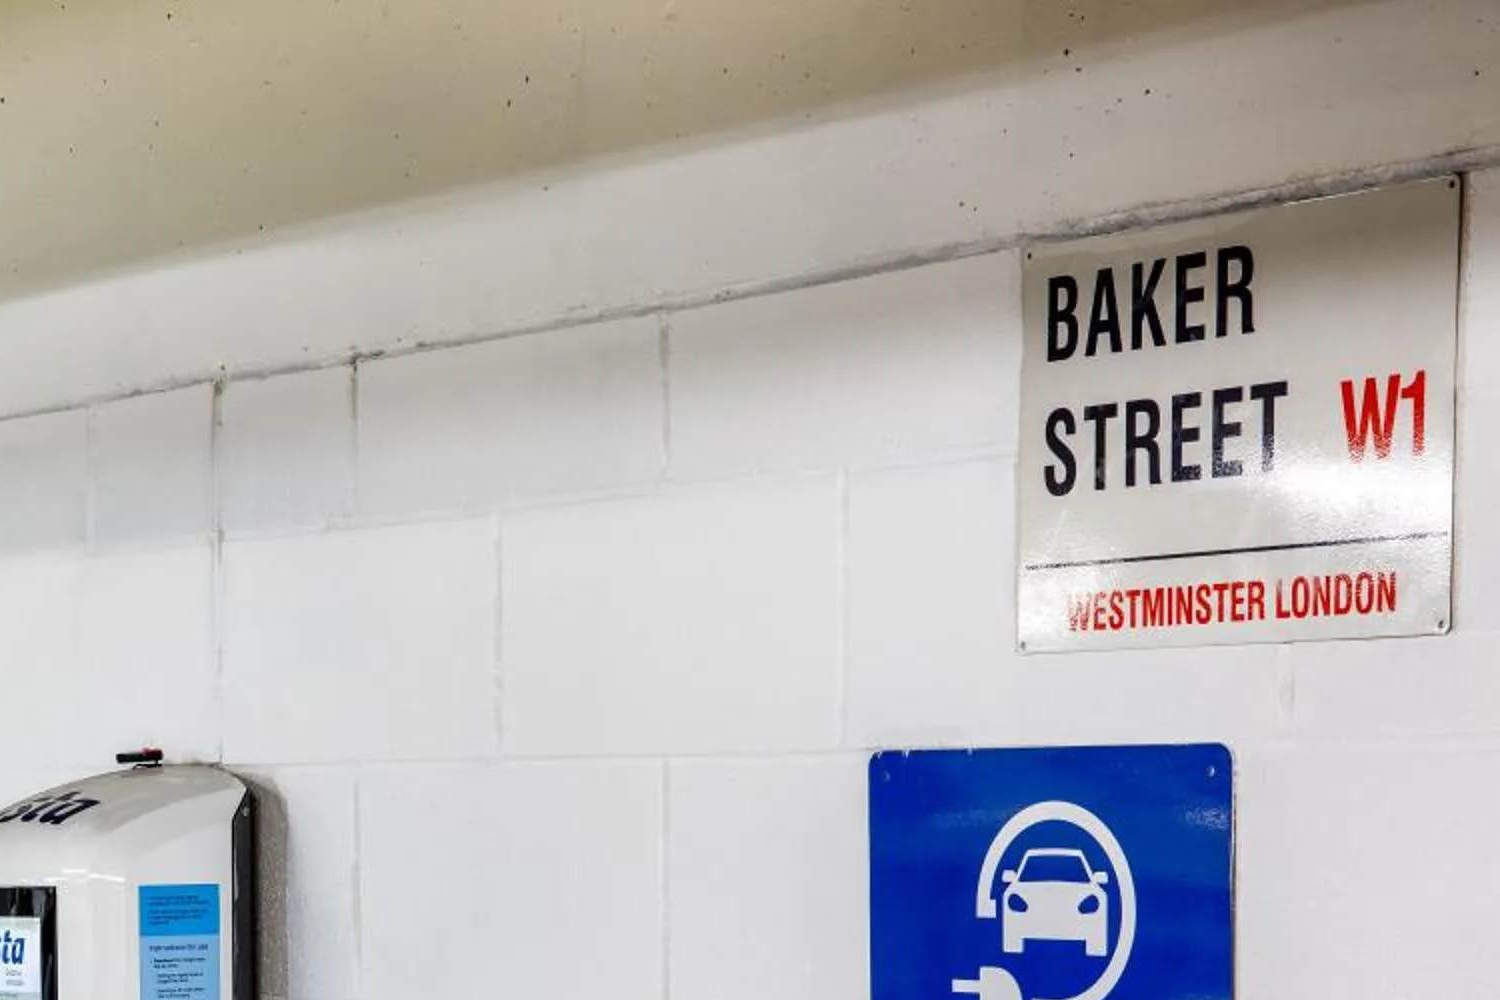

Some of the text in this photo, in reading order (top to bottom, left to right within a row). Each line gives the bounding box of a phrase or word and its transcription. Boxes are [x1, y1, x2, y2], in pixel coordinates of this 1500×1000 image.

[1046, 245, 1256, 363] BAKER
[1043, 369, 1427, 497] STREET W1
[1066, 571, 1398, 633] WESTMINSTER LONDON
